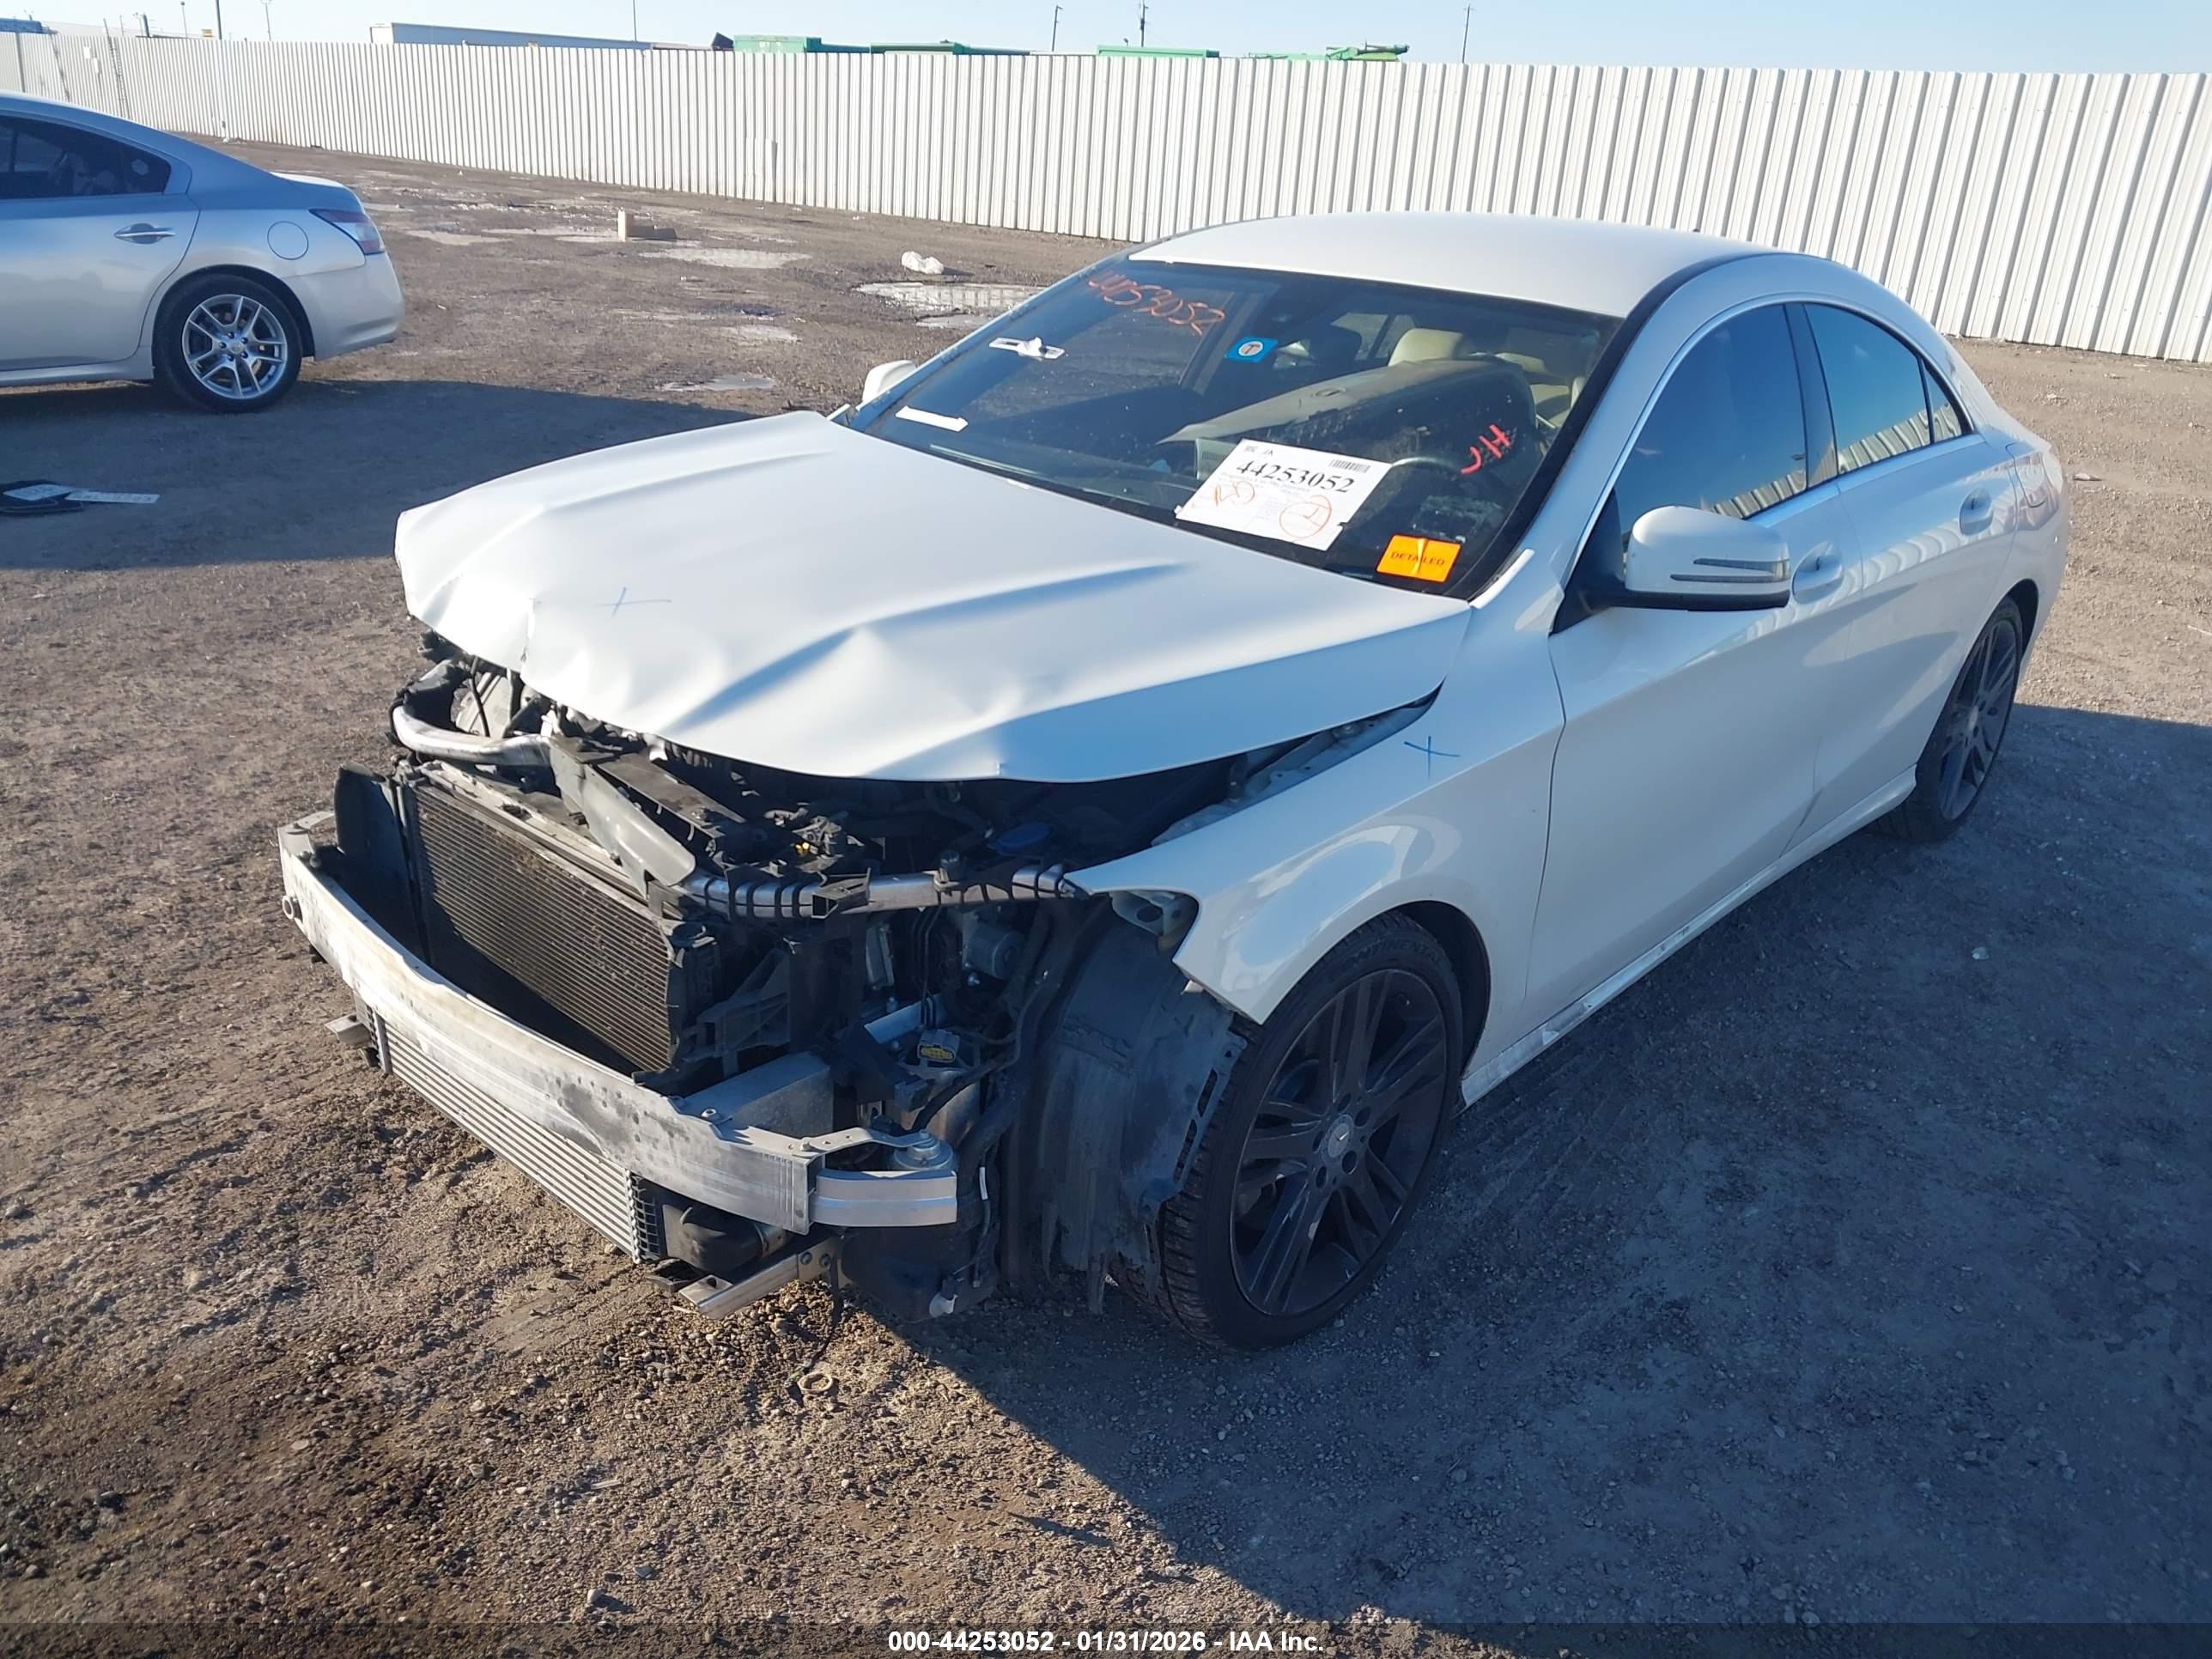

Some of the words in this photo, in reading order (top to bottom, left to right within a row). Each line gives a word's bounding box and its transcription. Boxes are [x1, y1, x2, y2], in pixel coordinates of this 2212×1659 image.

[1237, 459, 1355, 494] 44253052
[1390, 551, 1445, 566] DETALED
[1342, 938, 1442, 966] ONTINENTAL
